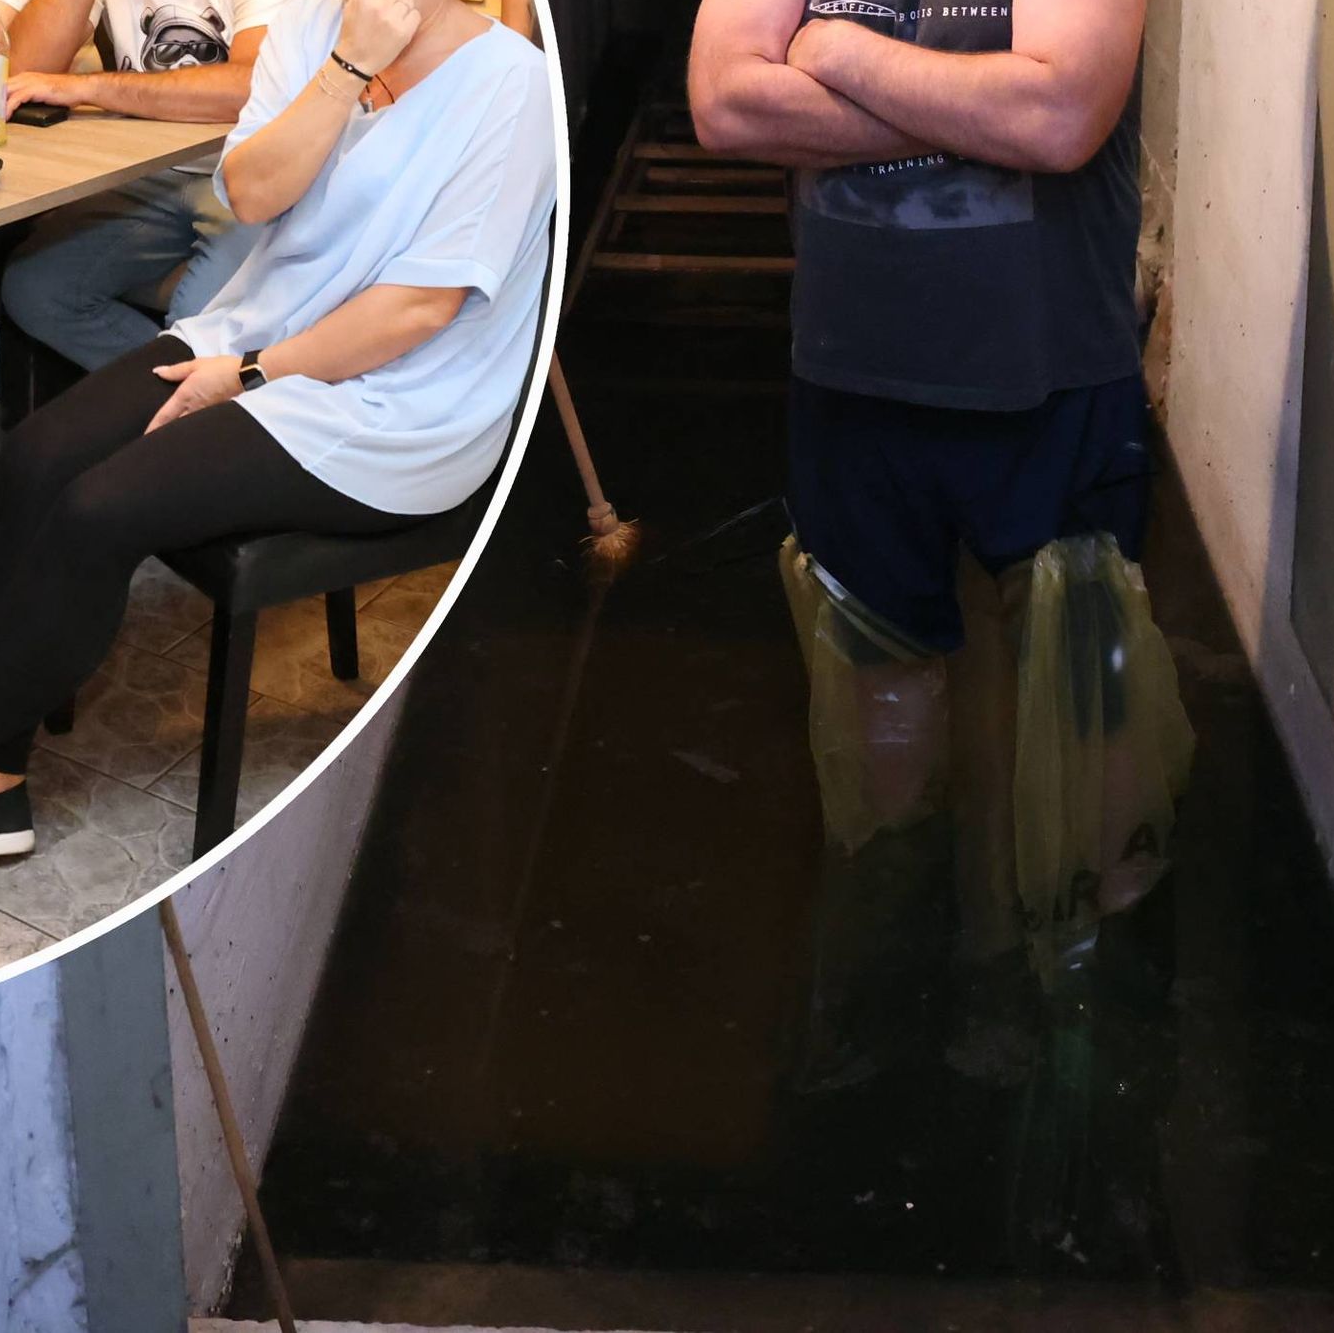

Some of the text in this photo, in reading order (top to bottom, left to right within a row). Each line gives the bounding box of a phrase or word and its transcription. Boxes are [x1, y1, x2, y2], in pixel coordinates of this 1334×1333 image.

[824, 1, 884, 17] PERFECT
[942, 6, 1009, 17] BETWEEN
[869, 154, 945, 175] TRAINING
